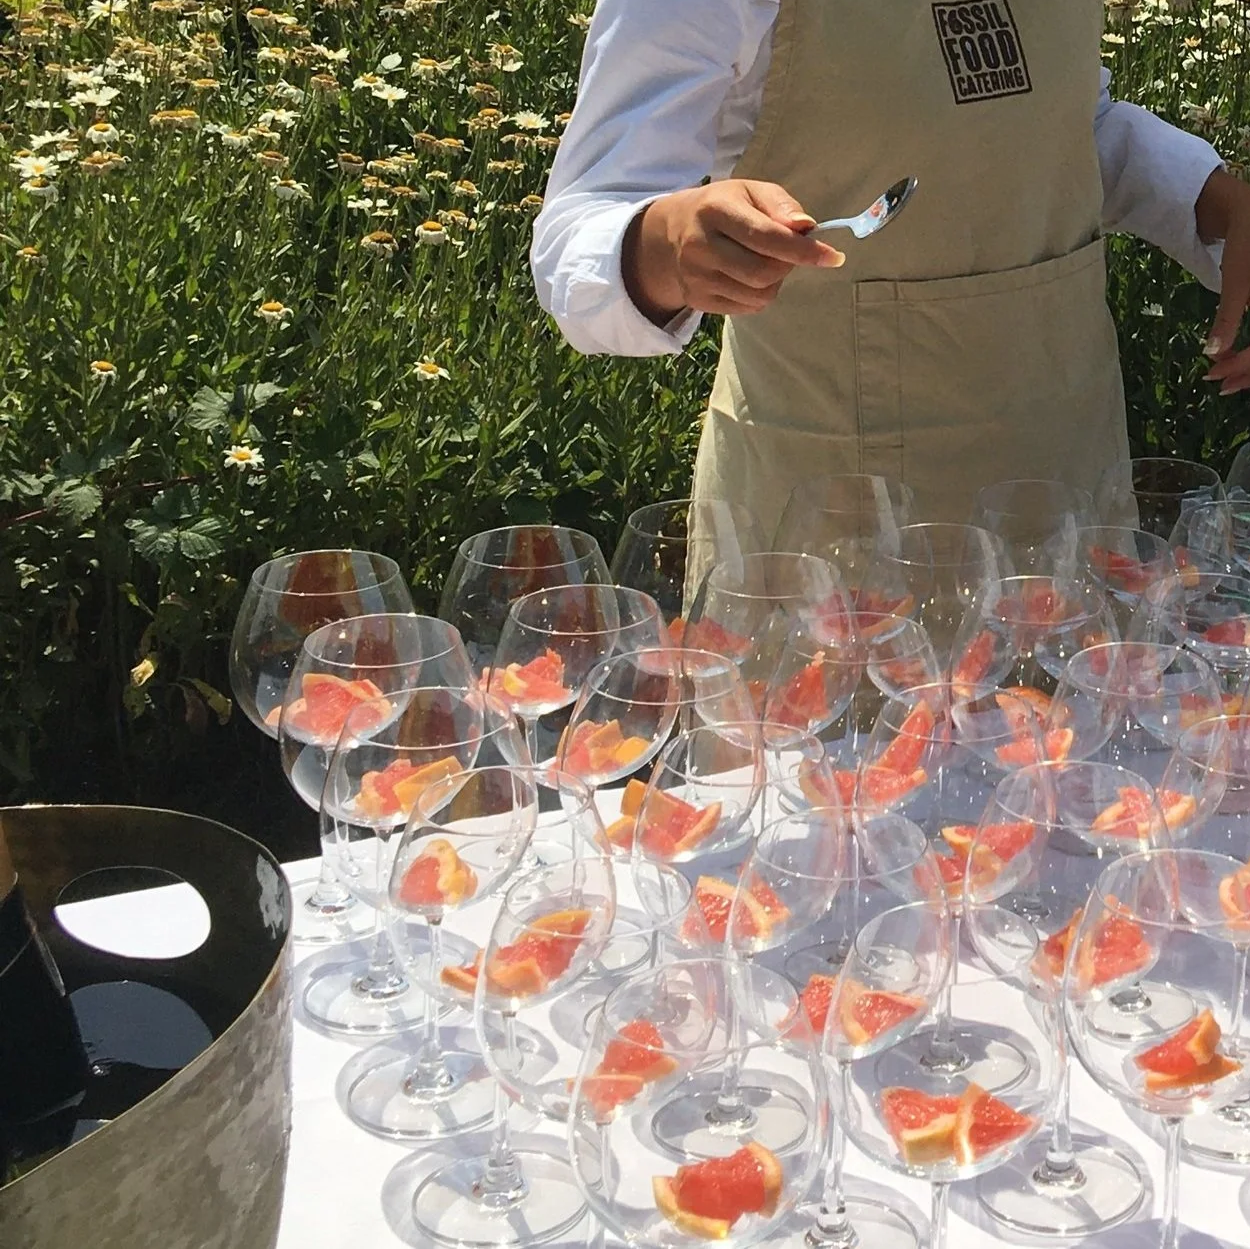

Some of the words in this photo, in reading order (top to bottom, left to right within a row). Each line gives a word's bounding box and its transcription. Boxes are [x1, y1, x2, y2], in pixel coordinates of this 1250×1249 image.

[937, 2, 1009, 37] FOSSIL
[945, 30, 1019, 75] FOOD
[957, 67, 1025, 97] CATERING
